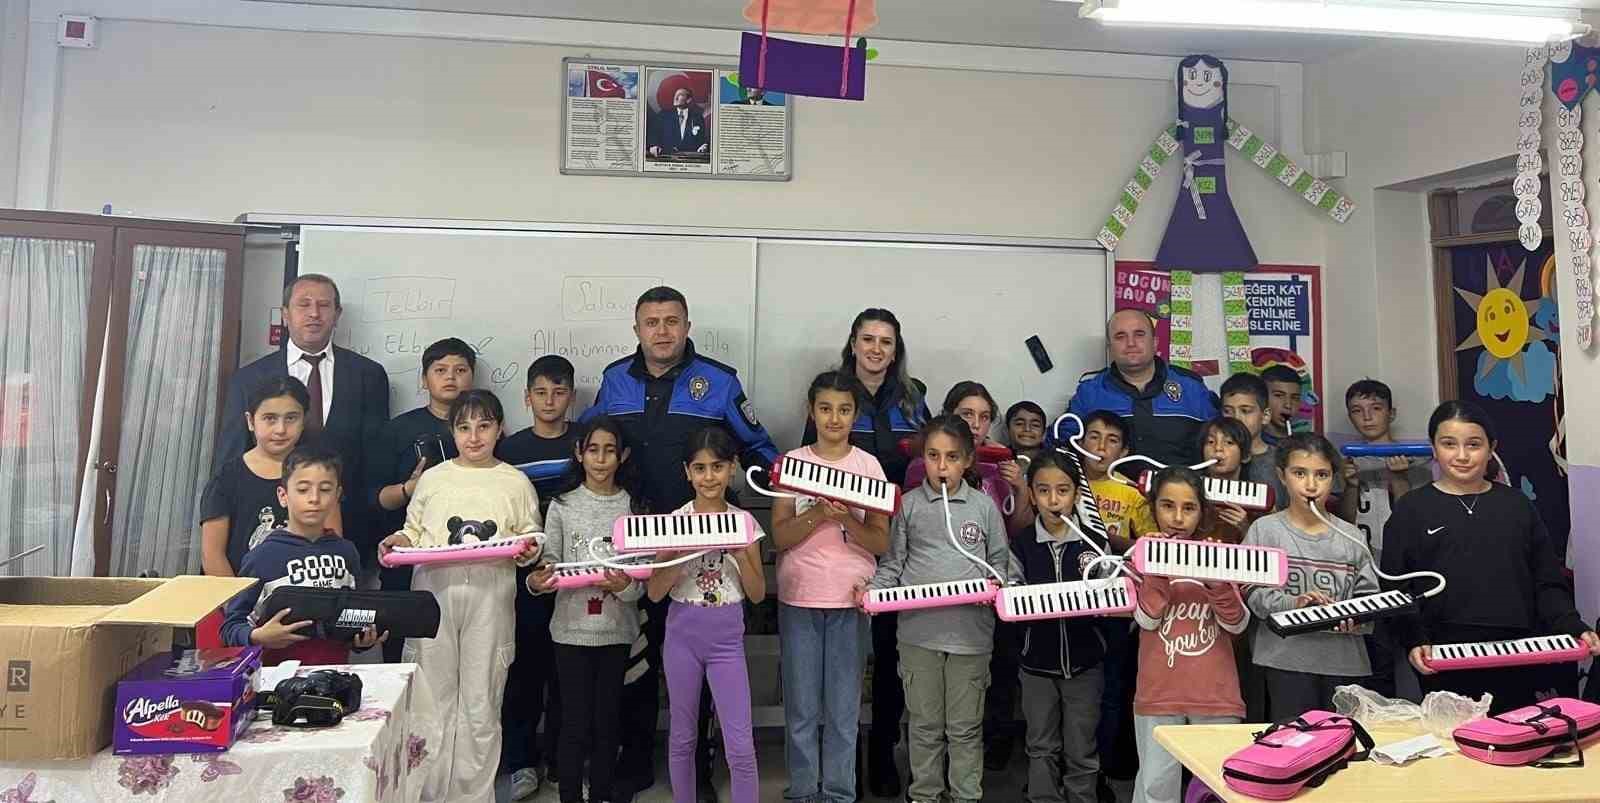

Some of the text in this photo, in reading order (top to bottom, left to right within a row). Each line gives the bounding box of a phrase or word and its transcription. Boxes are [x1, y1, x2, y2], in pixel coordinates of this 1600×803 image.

[1244, 283, 1276, 295] EĞER
[1279, 284, 1303, 296] KAT
[1249, 319, 1301, 331] SLERİNE
[287, 555, 345, 585] GOOD
[1159, 625, 1216, 668] you ca
[124, 695, 180, 724] Alpella
